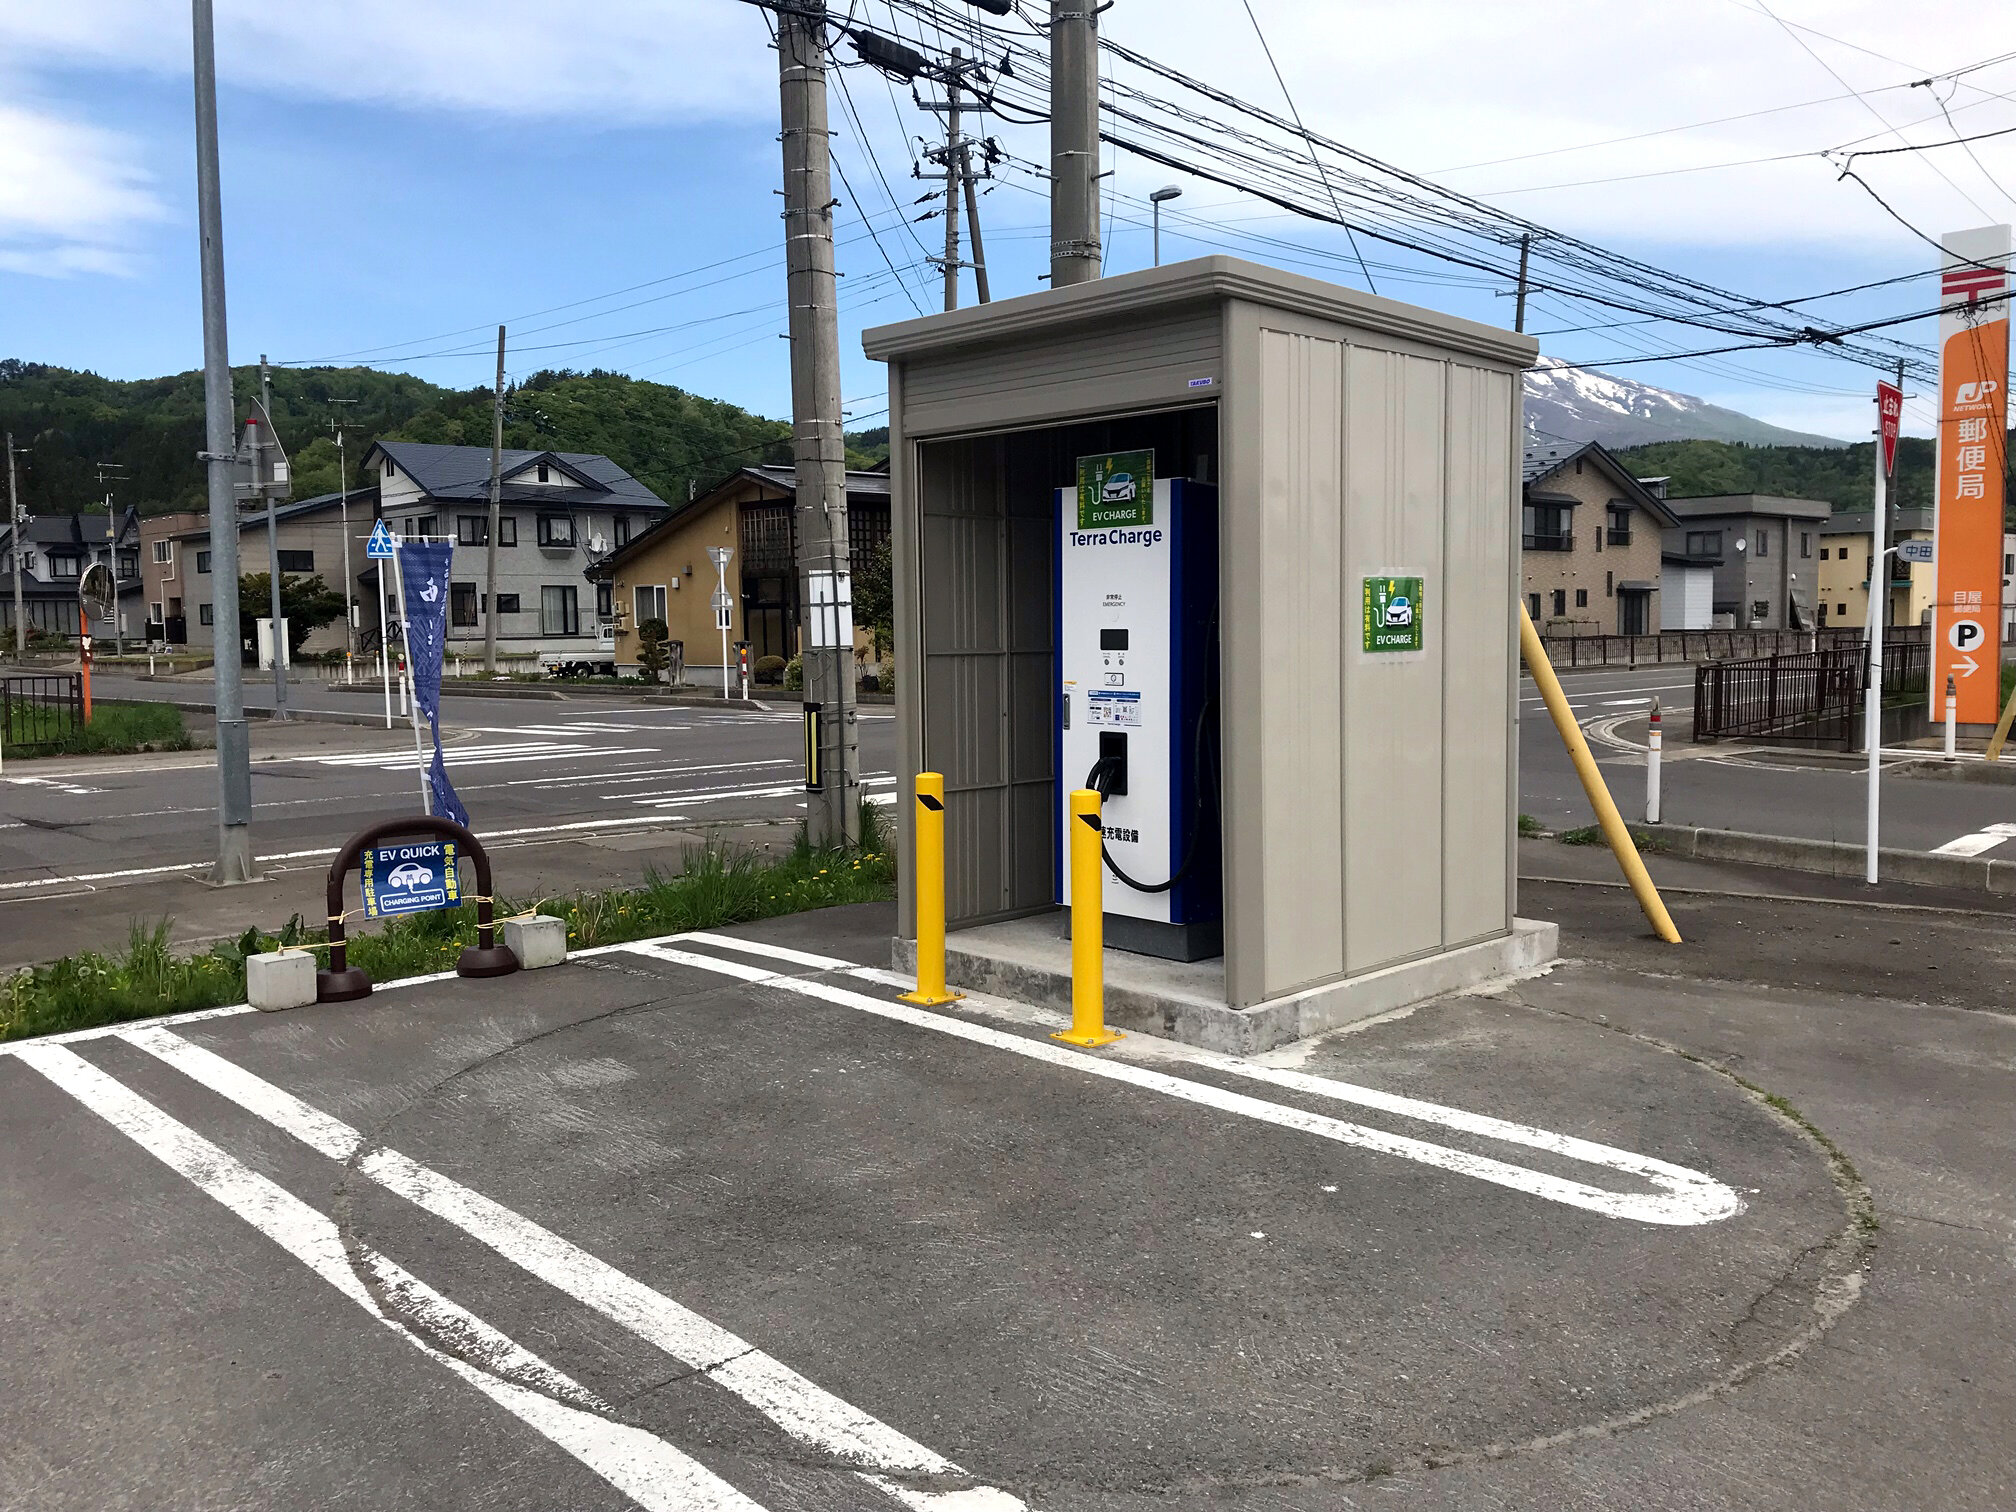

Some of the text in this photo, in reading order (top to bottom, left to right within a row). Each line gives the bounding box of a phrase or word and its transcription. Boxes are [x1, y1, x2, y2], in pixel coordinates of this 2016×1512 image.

[1883, 394, 1899, 417] 止まれ
[1953, 403, 1993, 412] NETWORK
[1885, 421, 1897, 439] STOP
[1955, 417, 1987, 500] 郵便局
[1092, 509, 1137, 521] EV CHARGE
[1069, 530, 1162, 548] Terra Charge
[1905, 545, 1933, 557] 中田
[1954, 591, 1983, 604] 目屋
[1376, 634, 1412, 645] EV CHARGE
[1957, 624, 1978, 647] P
[379, 845, 440, 861] EV QUICK
[443, 843, 459, 901] 電気自動車
[363, 850, 378, 917] 充電専用駐車場
[384, 893, 442, 907] CHARGING POINT
